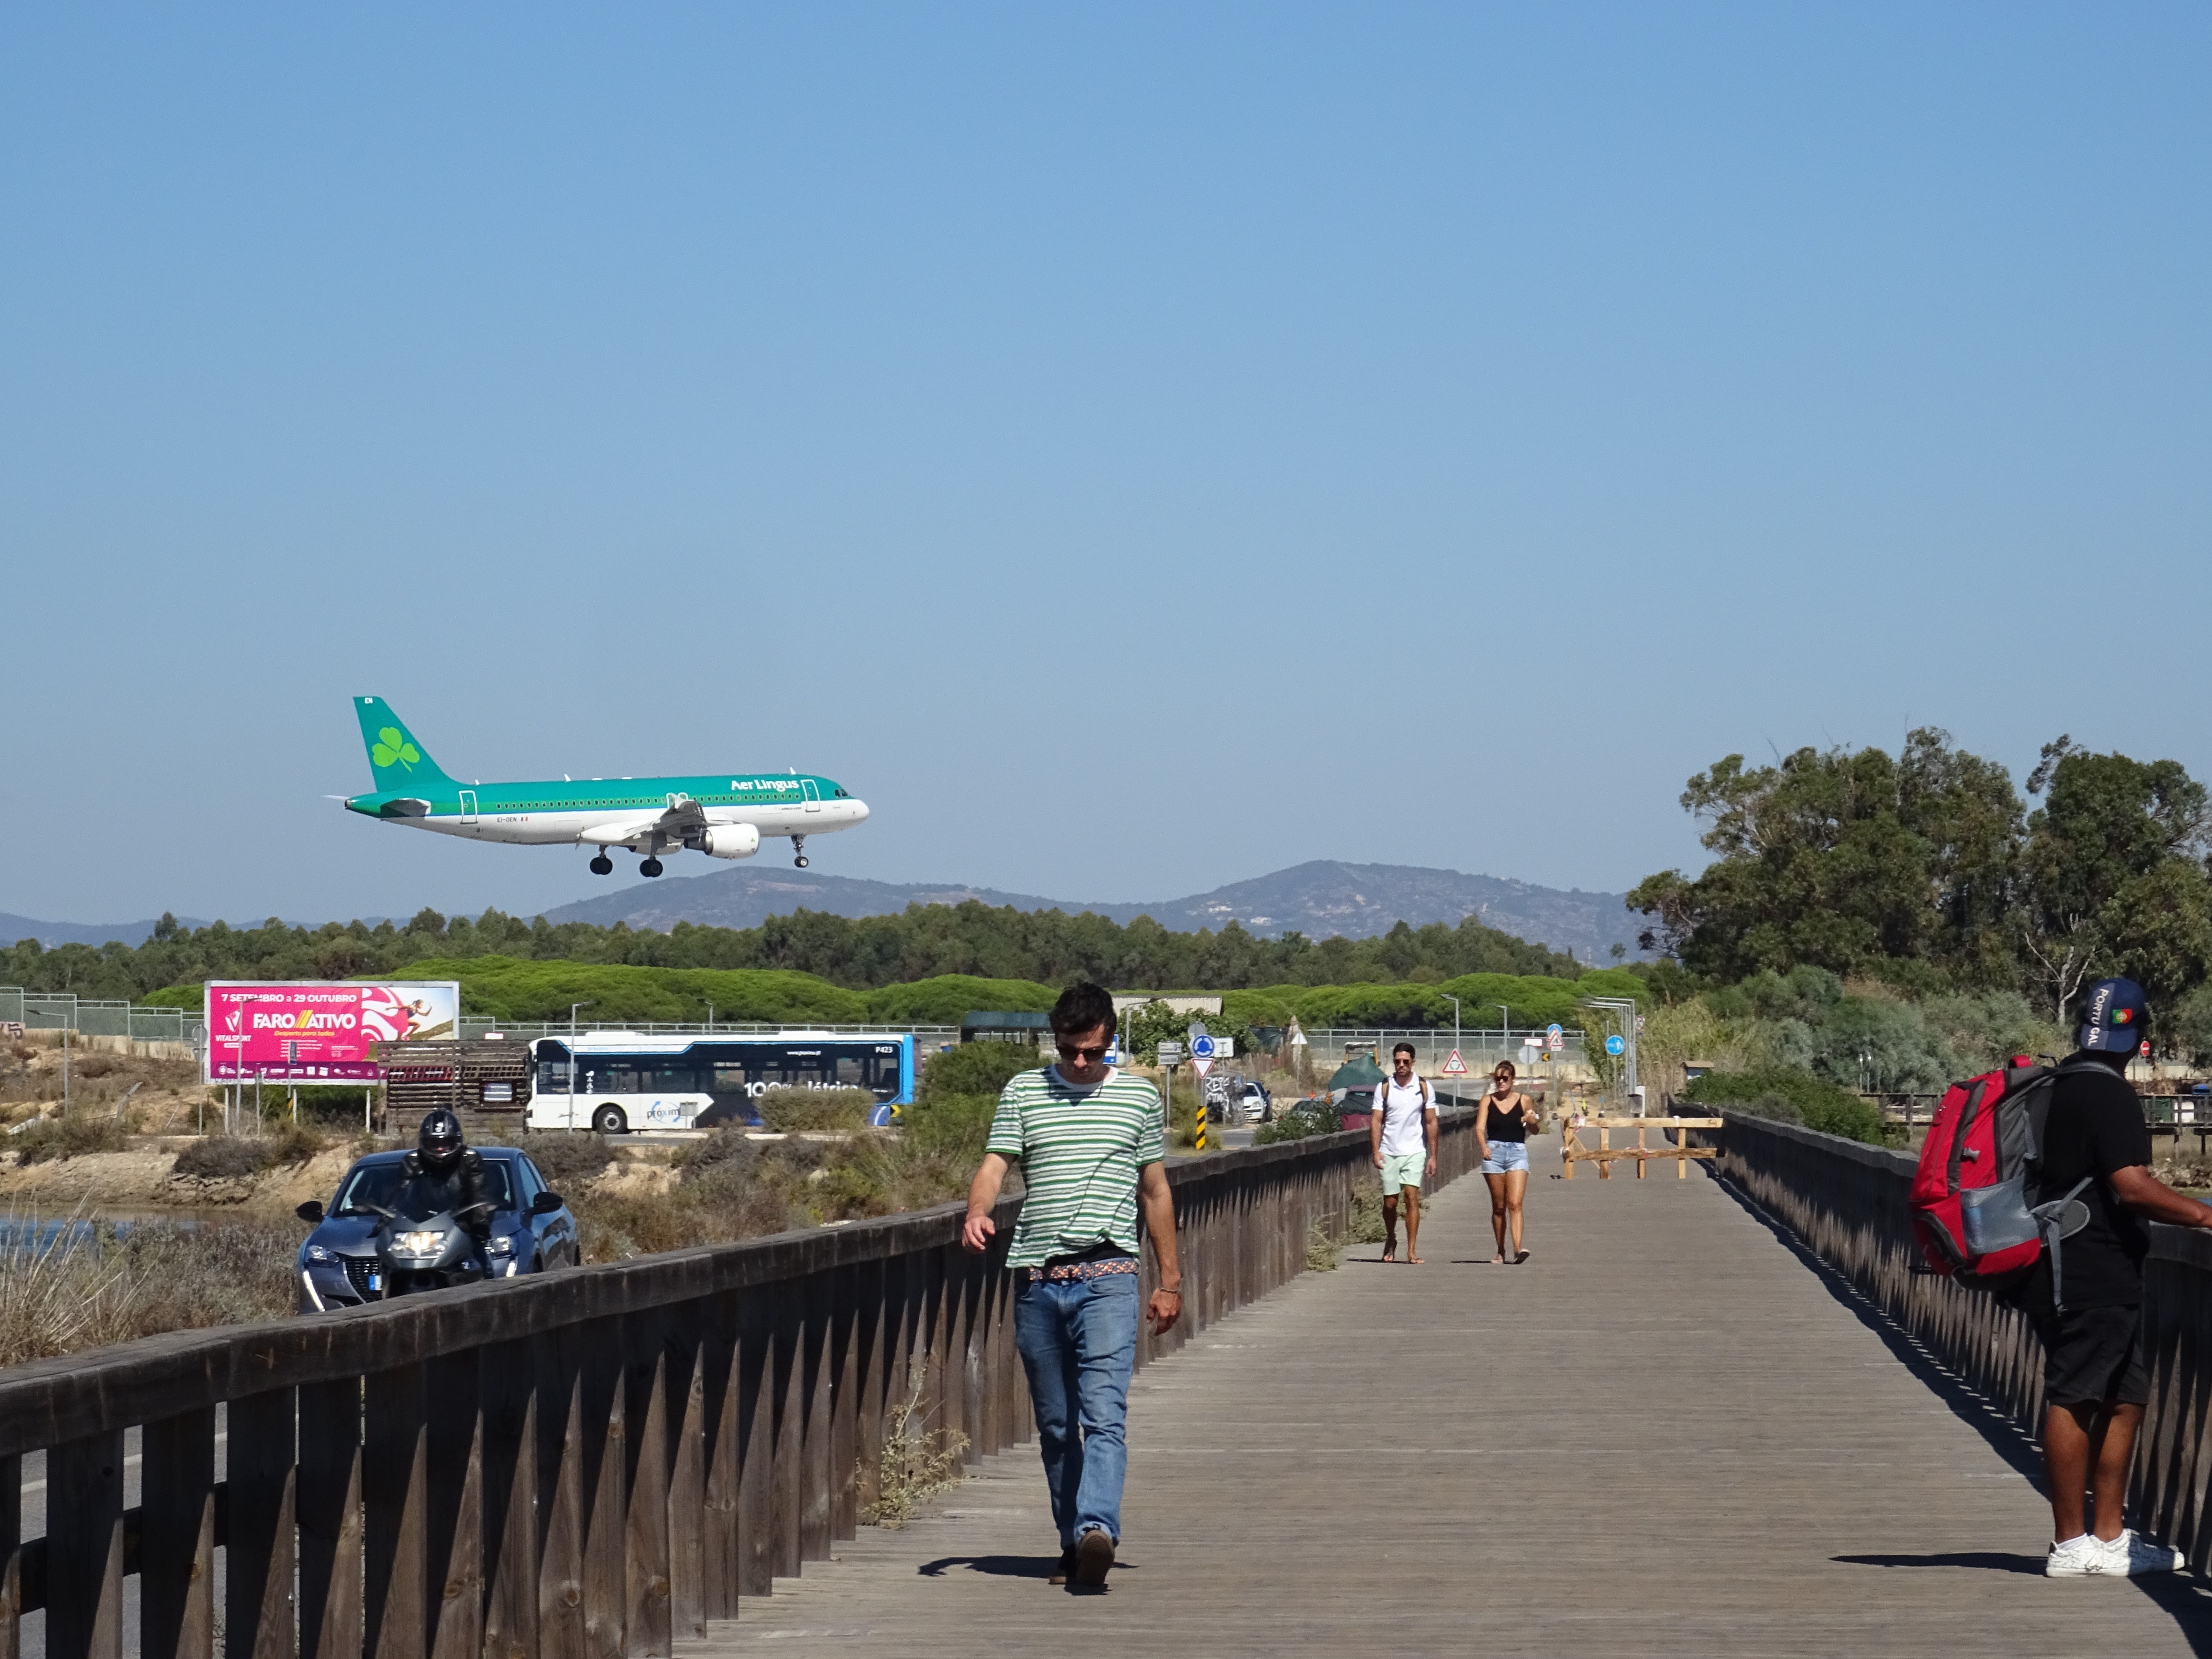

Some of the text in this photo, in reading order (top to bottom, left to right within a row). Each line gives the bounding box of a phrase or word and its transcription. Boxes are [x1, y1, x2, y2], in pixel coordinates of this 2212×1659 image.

[731, 779, 800, 792] Aer Lingus
[221, 994, 228, 1002] 7
[230, 994, 285, 1002] SETEMBRO
[293, 994, 306, 1002] 29
[307, 994, 357, 1002] OUTUBRO
[253, 1013, 357, 1029] FARO ATIVO
[2087, 988, 2109, 1047] PORTUGAL
[646, 1107, 680, 1120] próxim
